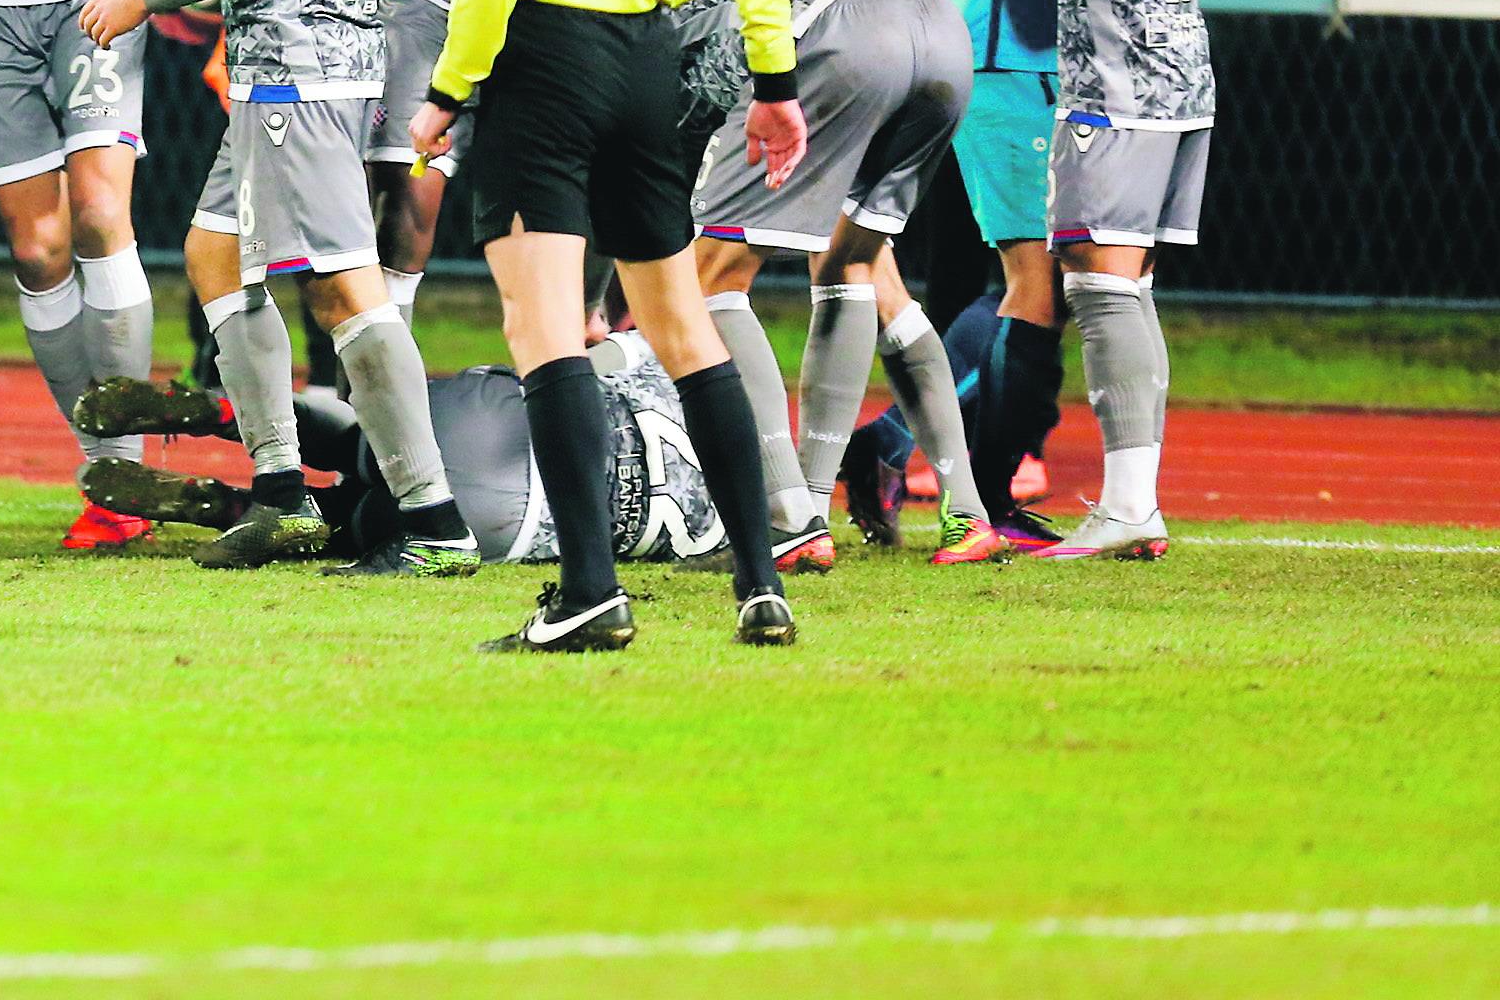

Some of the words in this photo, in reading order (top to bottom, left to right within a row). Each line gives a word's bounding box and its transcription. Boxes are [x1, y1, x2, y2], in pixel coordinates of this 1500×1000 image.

[68, 49, 123, 109] 23
[239, 179, 255, 237] 8
[612, 465, 631, 537] BANKA
[618, 463, 643, 553] SPLITSKA
